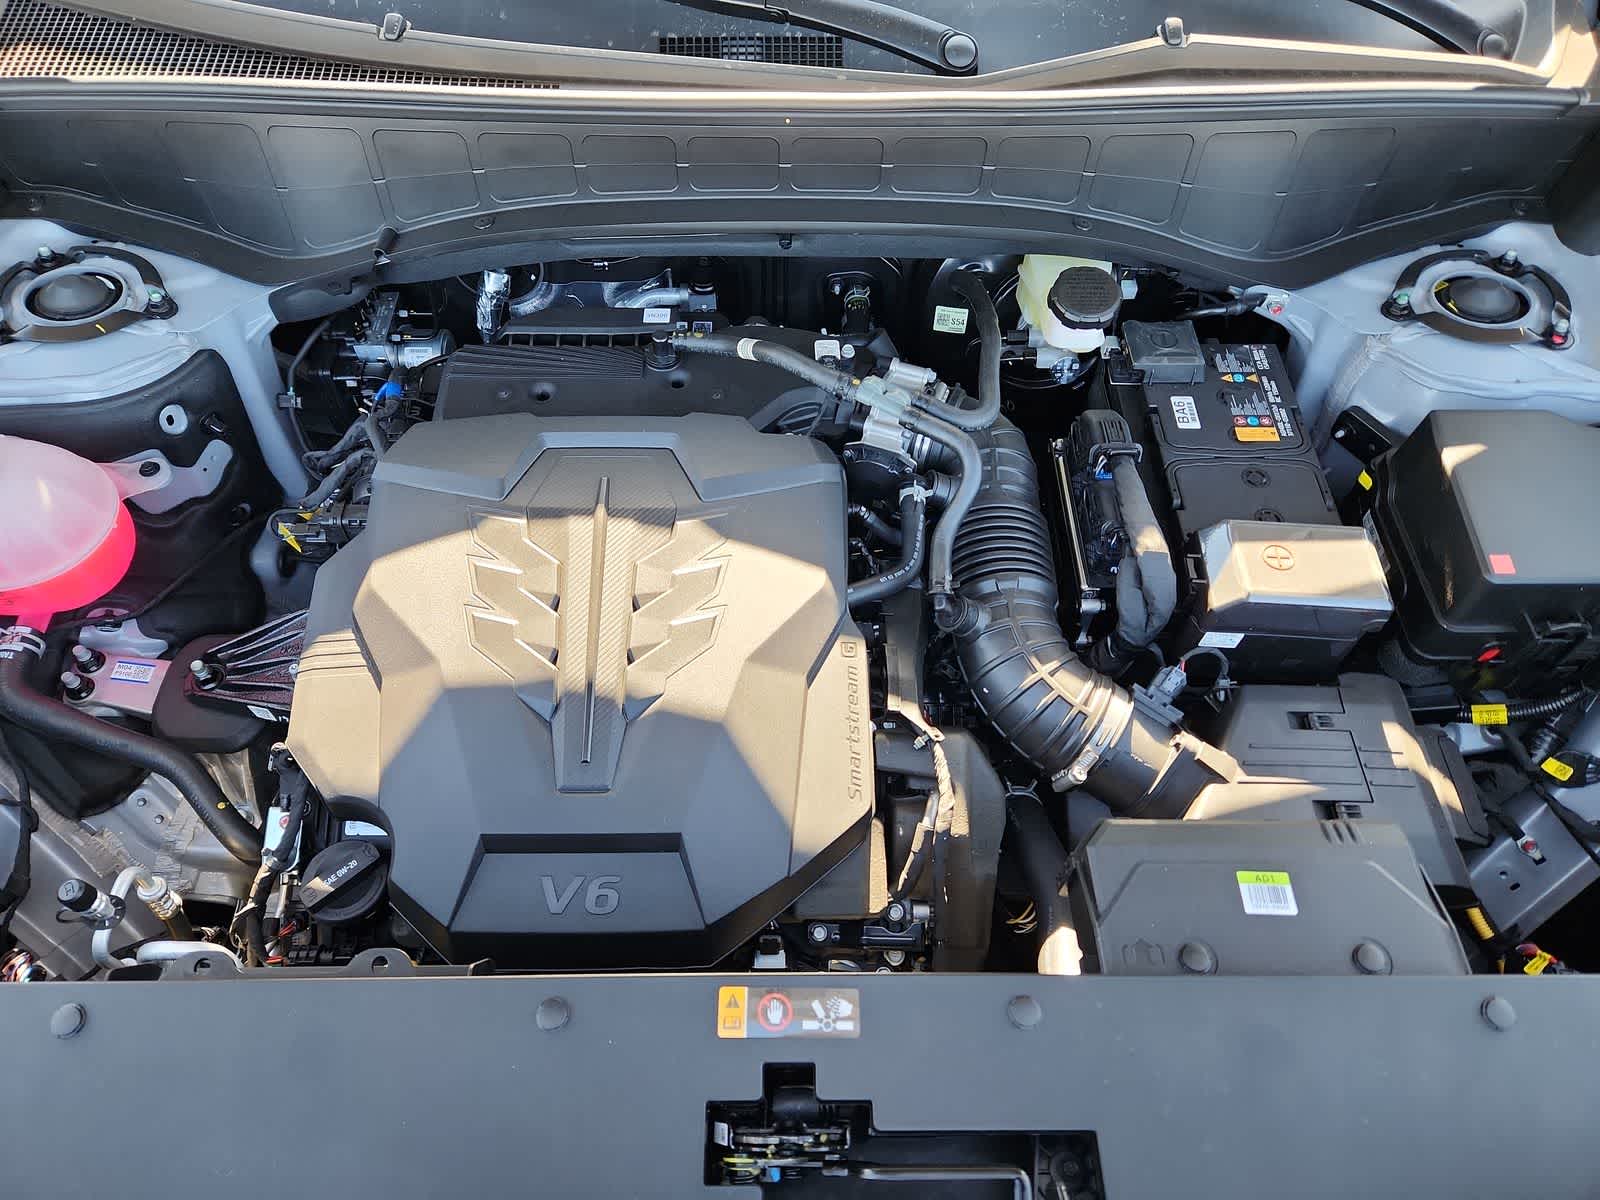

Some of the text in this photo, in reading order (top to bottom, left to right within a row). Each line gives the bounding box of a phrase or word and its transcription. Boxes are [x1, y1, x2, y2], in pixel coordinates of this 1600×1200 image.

[951, 318, 965, 326] S54
[1174, 401, 1190, 424] BA6
[847, 665, 863, 801] Smartstream
[323, 859, 358, 886] SAE 0W-20
[541, 874, 621, 916] V6
